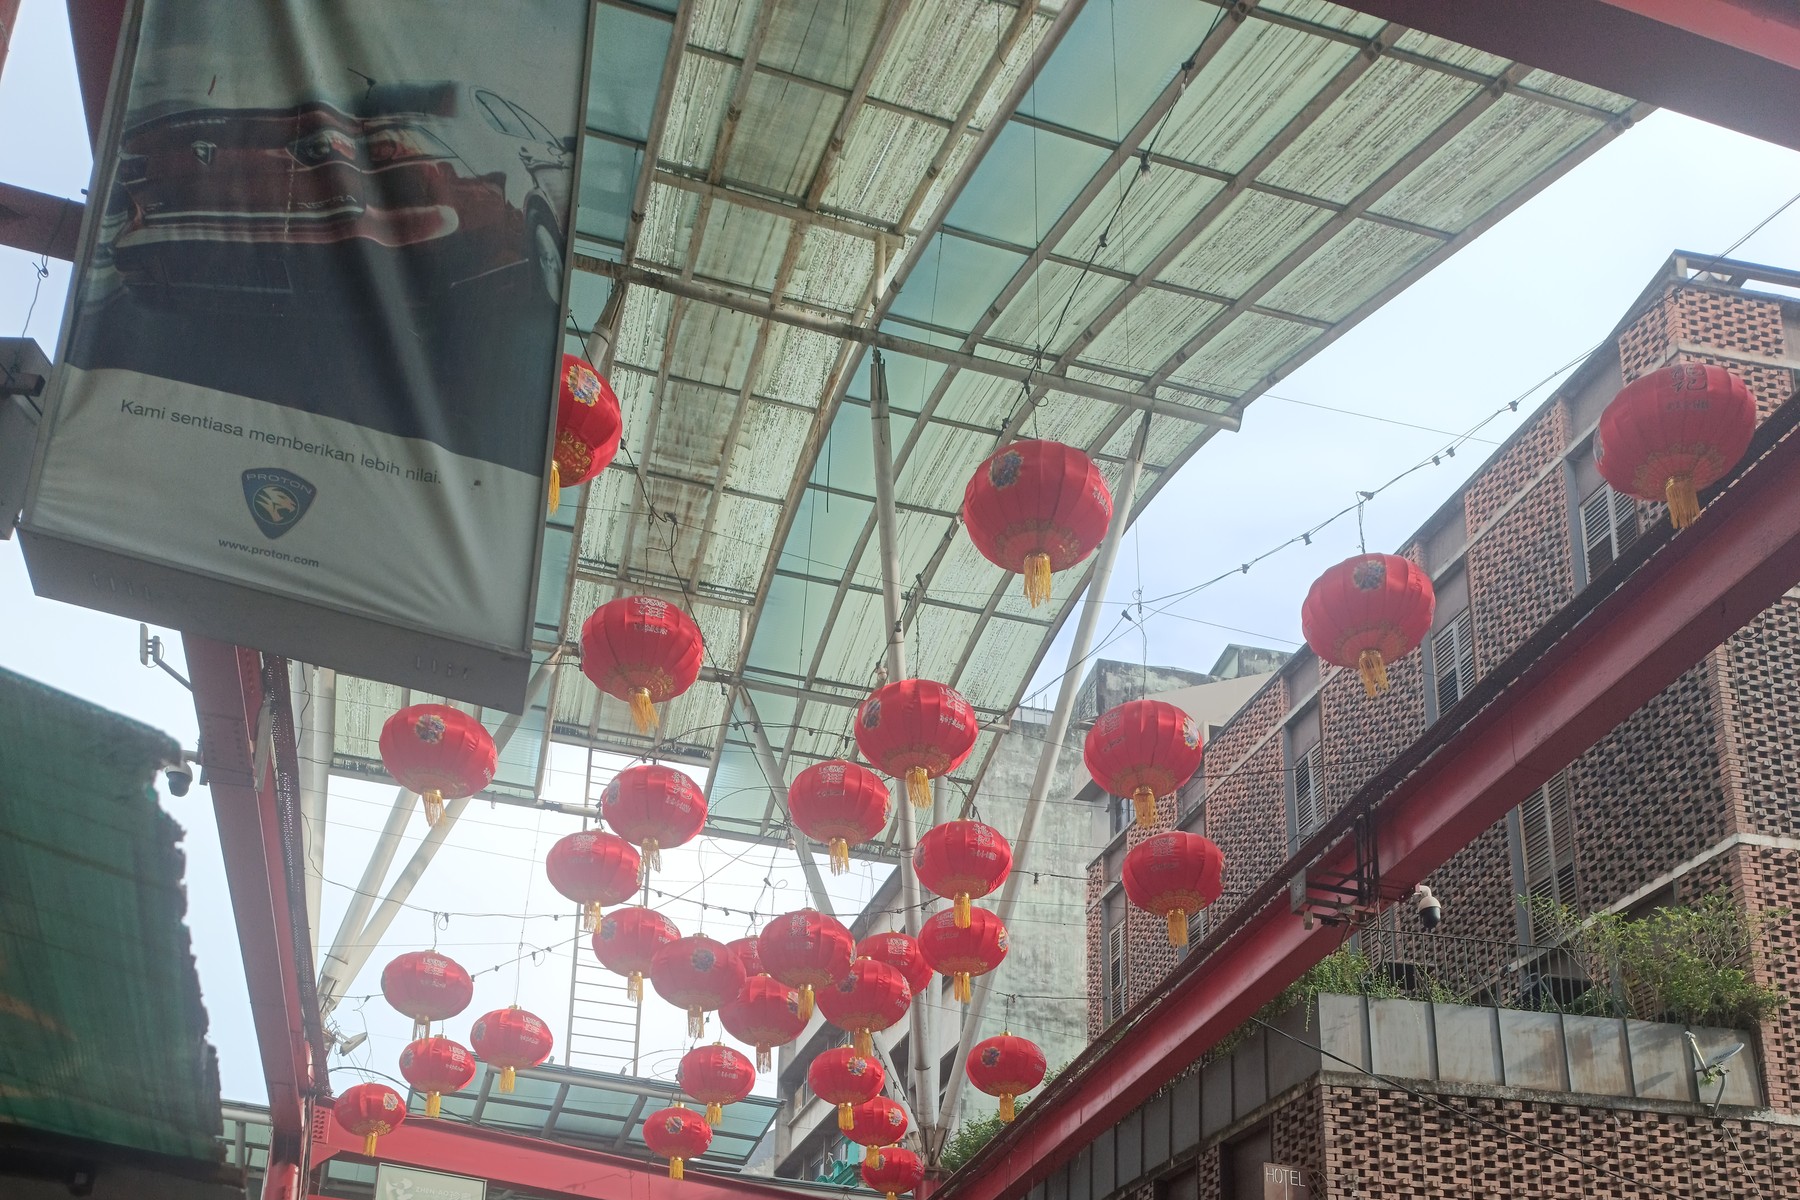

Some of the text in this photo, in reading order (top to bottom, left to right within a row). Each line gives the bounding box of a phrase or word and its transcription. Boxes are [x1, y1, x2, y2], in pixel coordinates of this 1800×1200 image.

[120, 399, 442, 484] Kami sentiasa memberikan lebih nilai.
[246, 473, 312, 494] PROTON
[218, 539, 320, 568] www.proton.com
[1266, 1167, 1305, 1187] HOTEL
